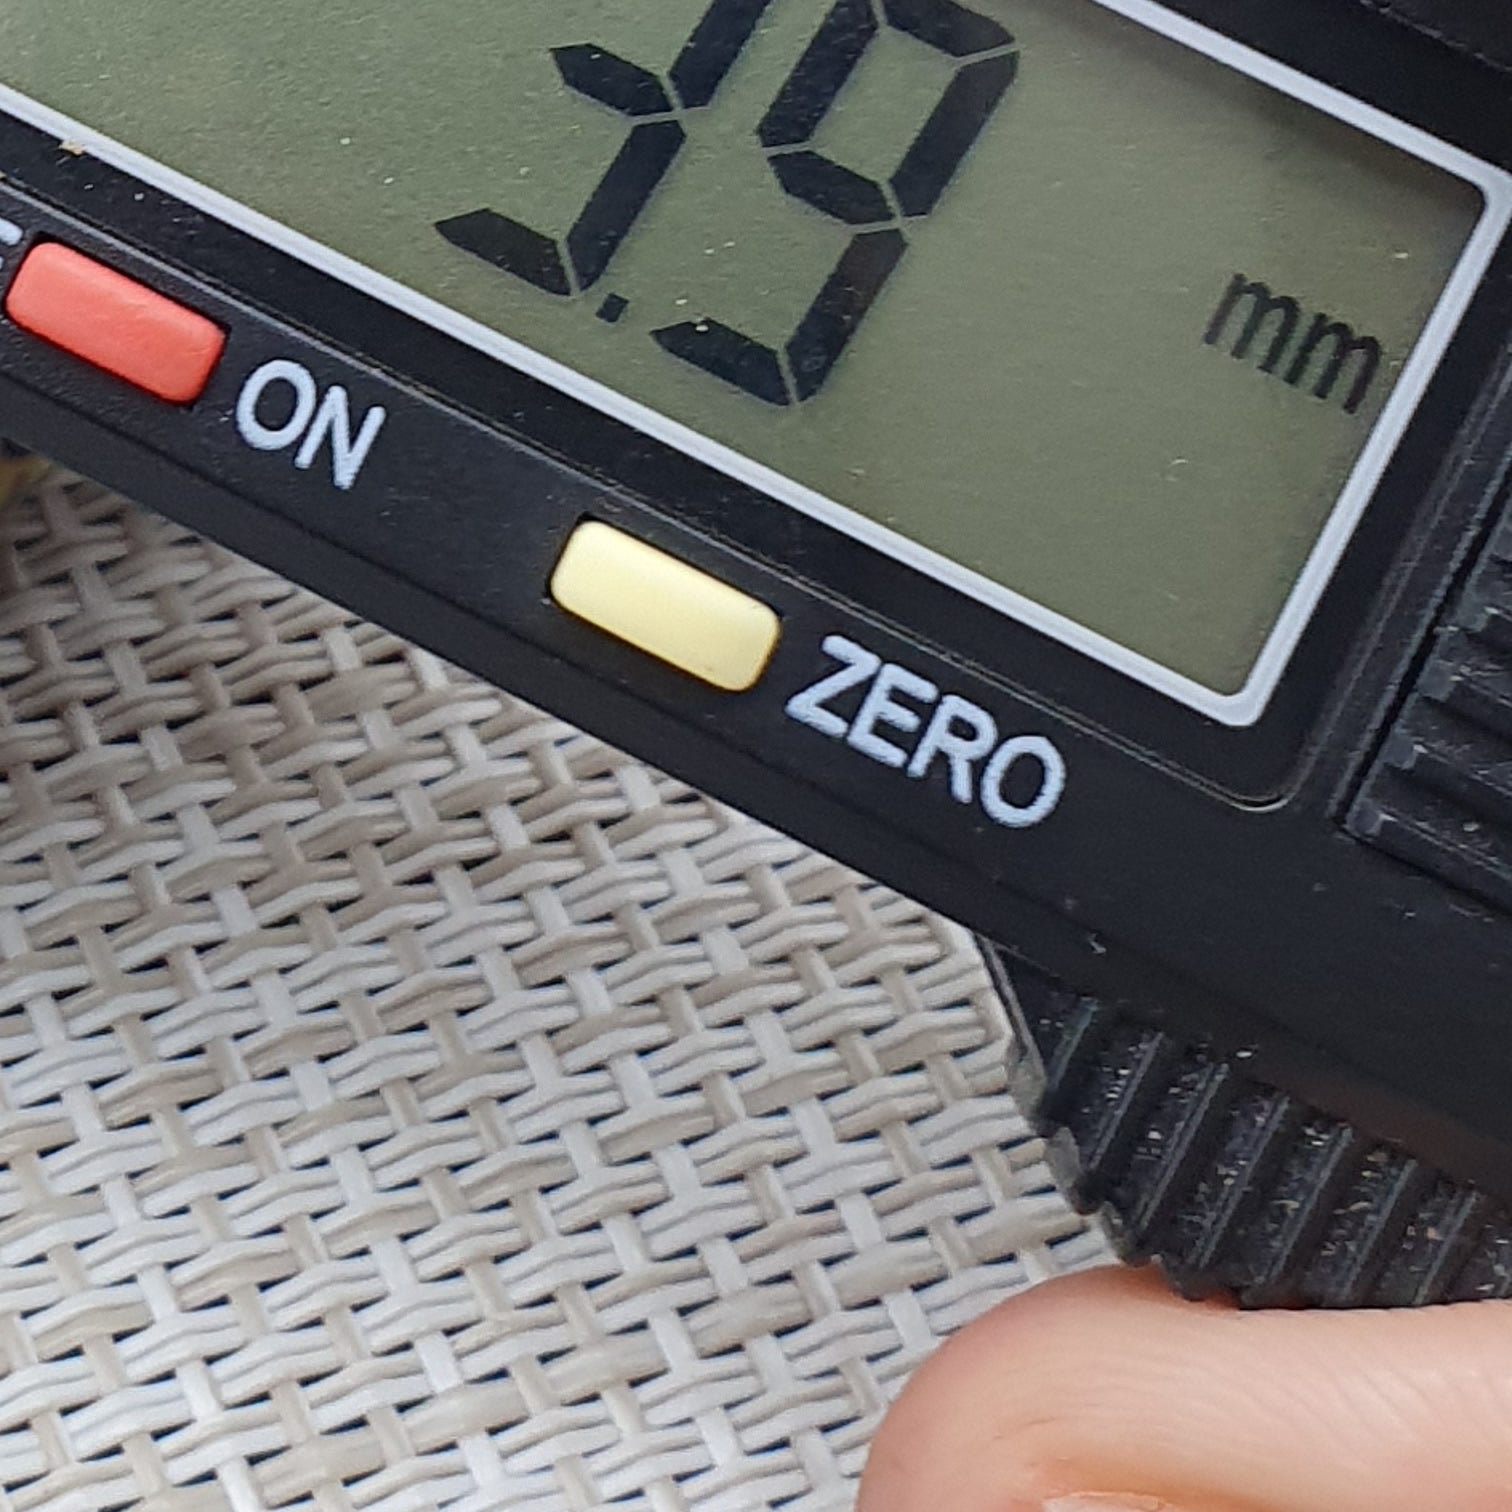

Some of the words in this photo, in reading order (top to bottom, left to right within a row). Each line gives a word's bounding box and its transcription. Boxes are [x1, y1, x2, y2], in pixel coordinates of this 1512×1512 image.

[1201, 272, 1383, 416] mm
[235, 359, 386, 490] ON
[784, 634, 1066, 829] ZERO
